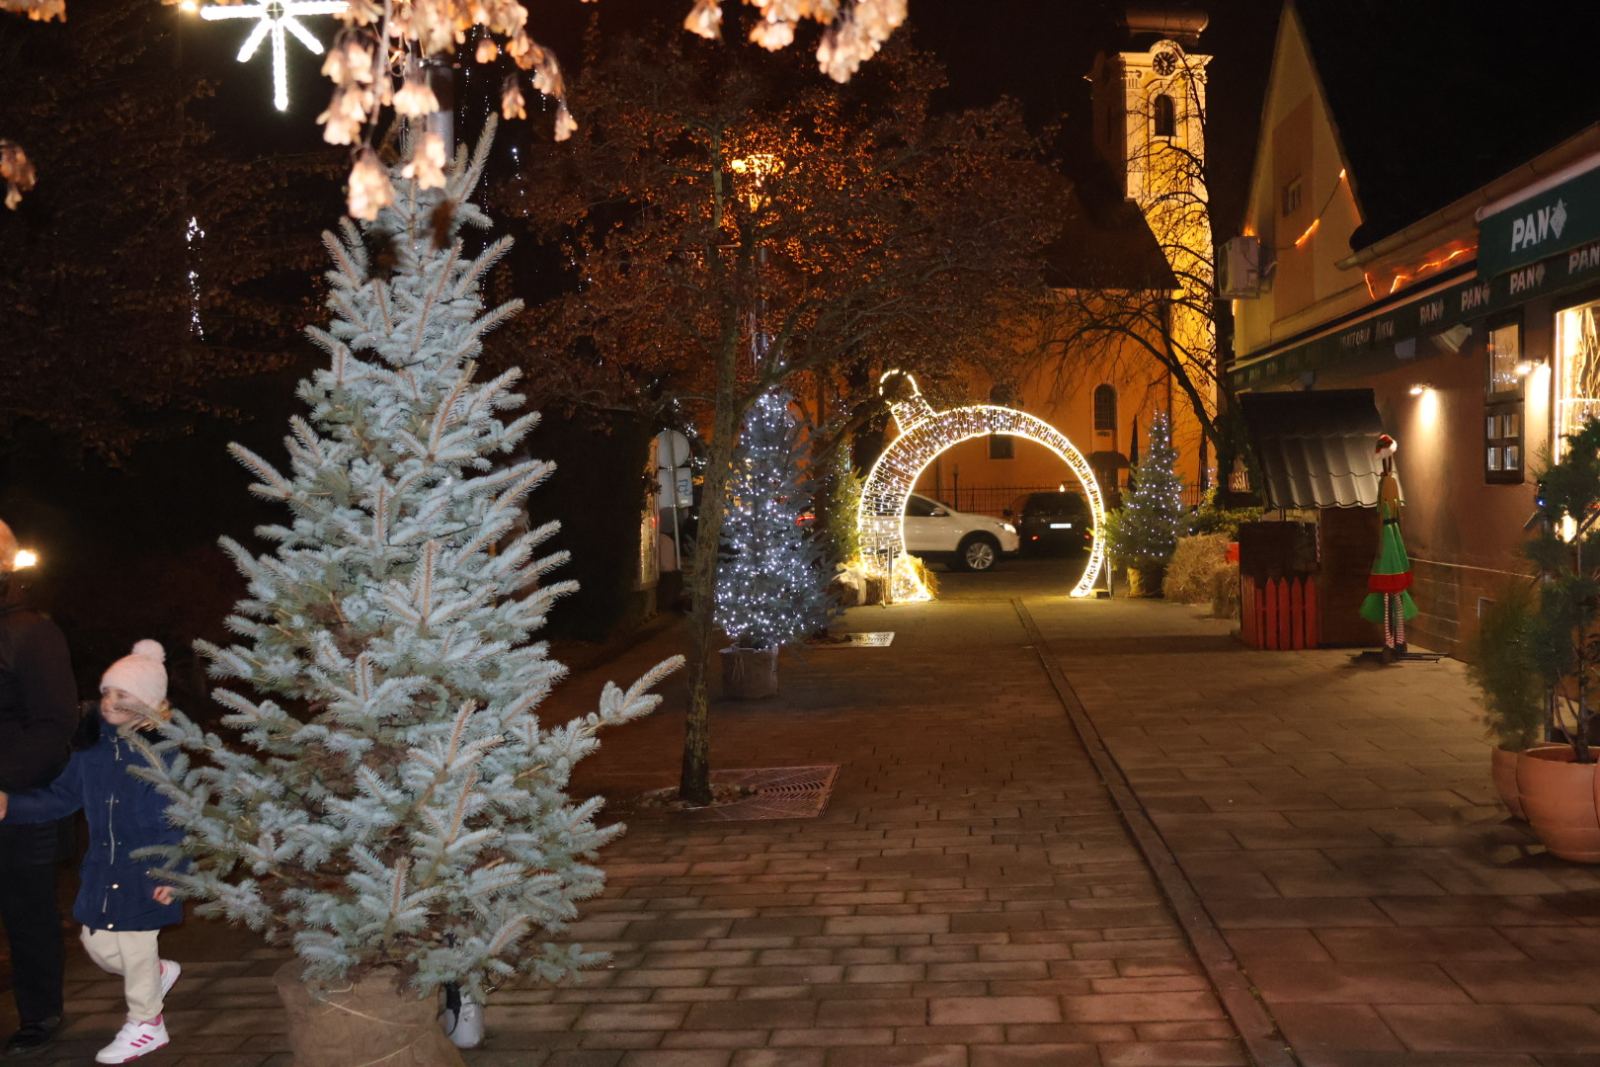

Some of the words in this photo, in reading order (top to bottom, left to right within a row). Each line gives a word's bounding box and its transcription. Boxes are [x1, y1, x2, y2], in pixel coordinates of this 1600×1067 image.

[1511, 206, 1550, 253] PAN
[1461, 286, 1482, 312] PAN
[1510, 268, 1534, 295] PAN
[1568, 245, 1600, 275] PAN
